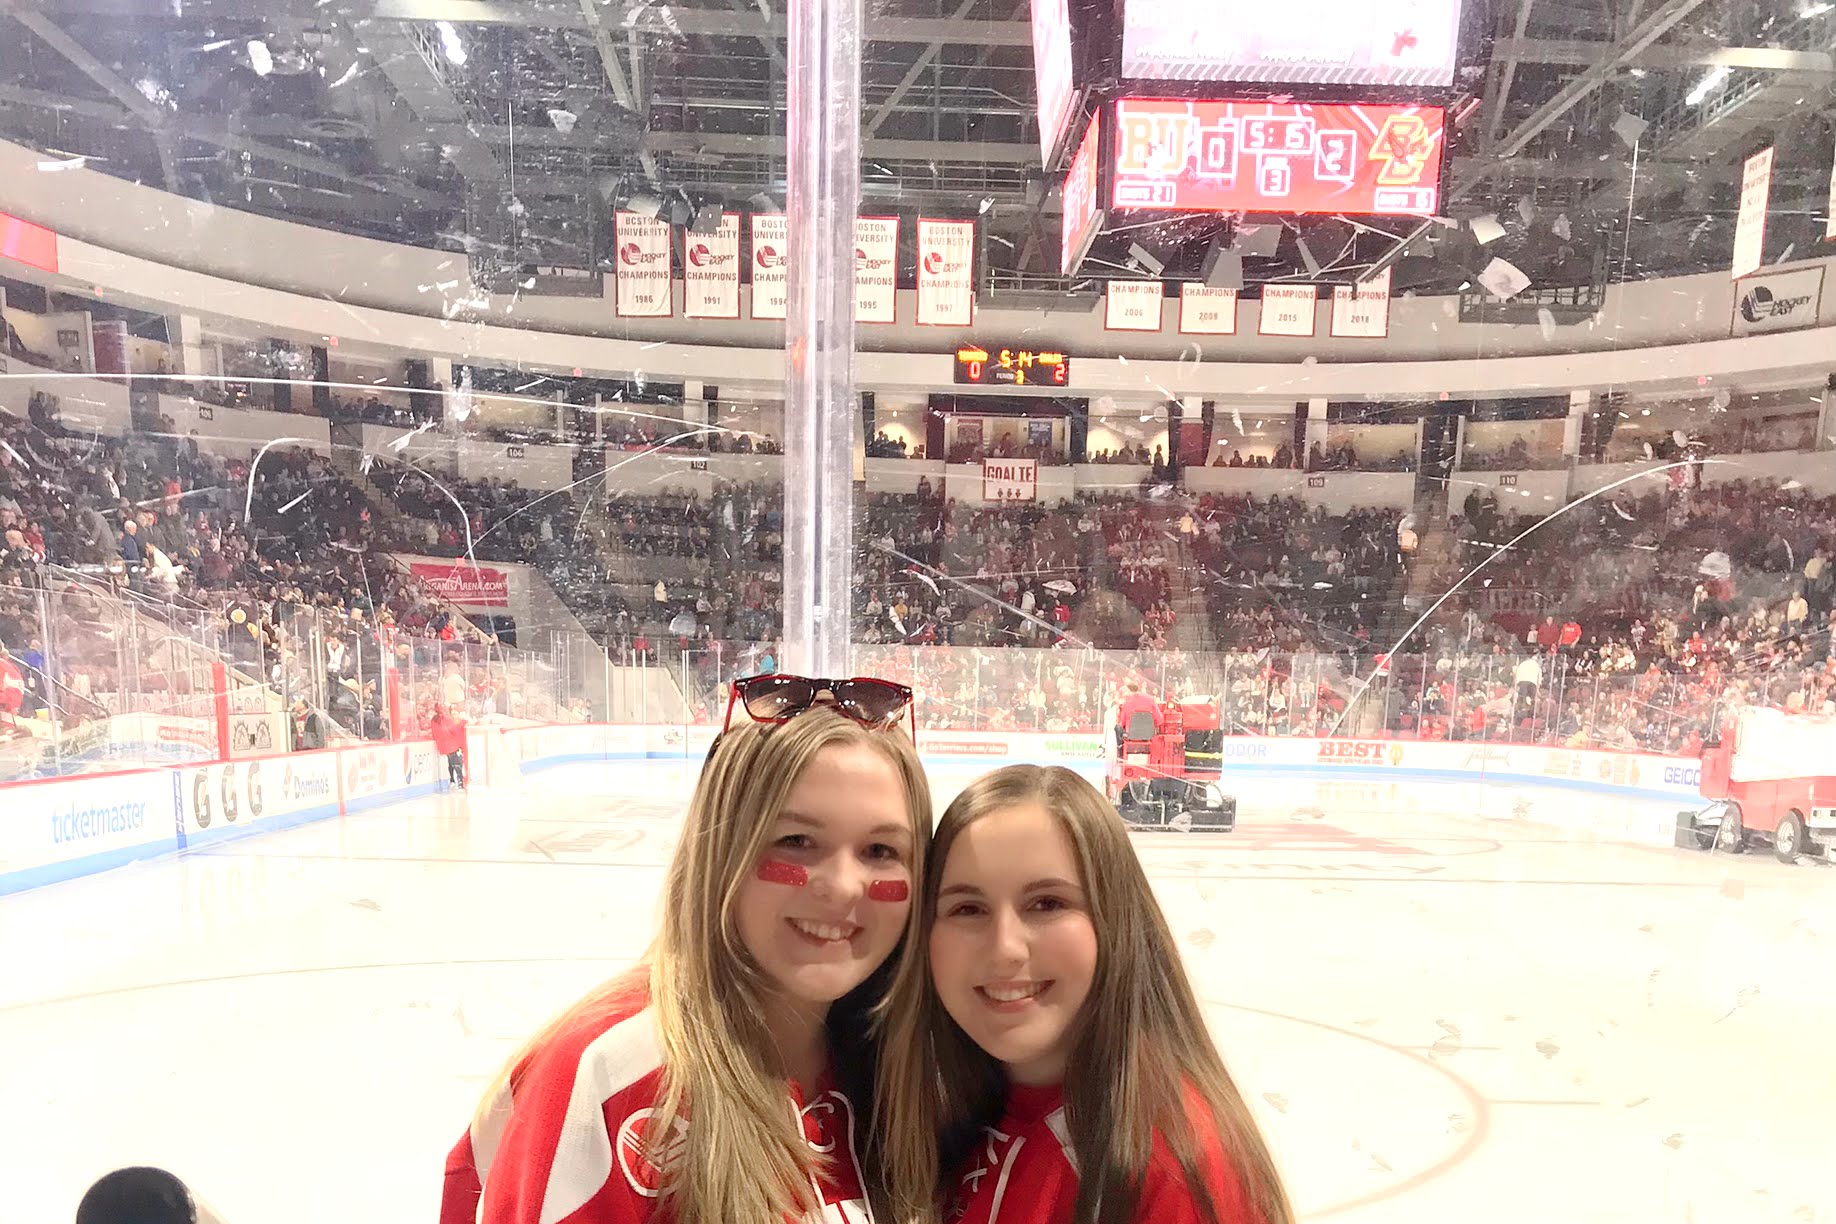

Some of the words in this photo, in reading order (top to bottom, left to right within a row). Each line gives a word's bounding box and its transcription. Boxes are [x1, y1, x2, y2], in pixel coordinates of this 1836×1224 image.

[1119, 114, 1191, 172] BU
[1207, 138, 1225, 168] 0
[1325, 139, 1344, 171] 2
[1270, 169, 1283, 191] 3
[618, 228, 669, 237] UNIVERSITY
[929, 226, 963, 235] BOSTON
[922, 237, 970, 246] UNIVERSITY
[618, 271, 669, 279] CHAMPIONS
[687, 272, 737, 281] CHAMPIONS
[921, 279, 970, 289] CHAMPIONS
[1111, 284, 1160, 295] CHAMPIONS
[1184, 288, 1235, 297] CHAMPIONS
[1265, 289, 1314, 299] CHAMPIONS
[704, 296, 721, 305] 1991
[859, 301, 877, 309] 1995
[1771, 295, 1812, 309] HOCKEY
[1278, 314, 1297, 322] 2015
[1001, 349, 1032, 368] 5:14
[970, 361, 981, 379] 0
[1055, 364, 1065, 380] 2
[1310, 478, 1323, 486] 109
[1045, 740, 1098, 751] SULLIVAN
[1318, 741, 1386, 758] BEST
[294, 772, 329, 799] Domino's
[52, 801, 145, 843] ticketmaster
